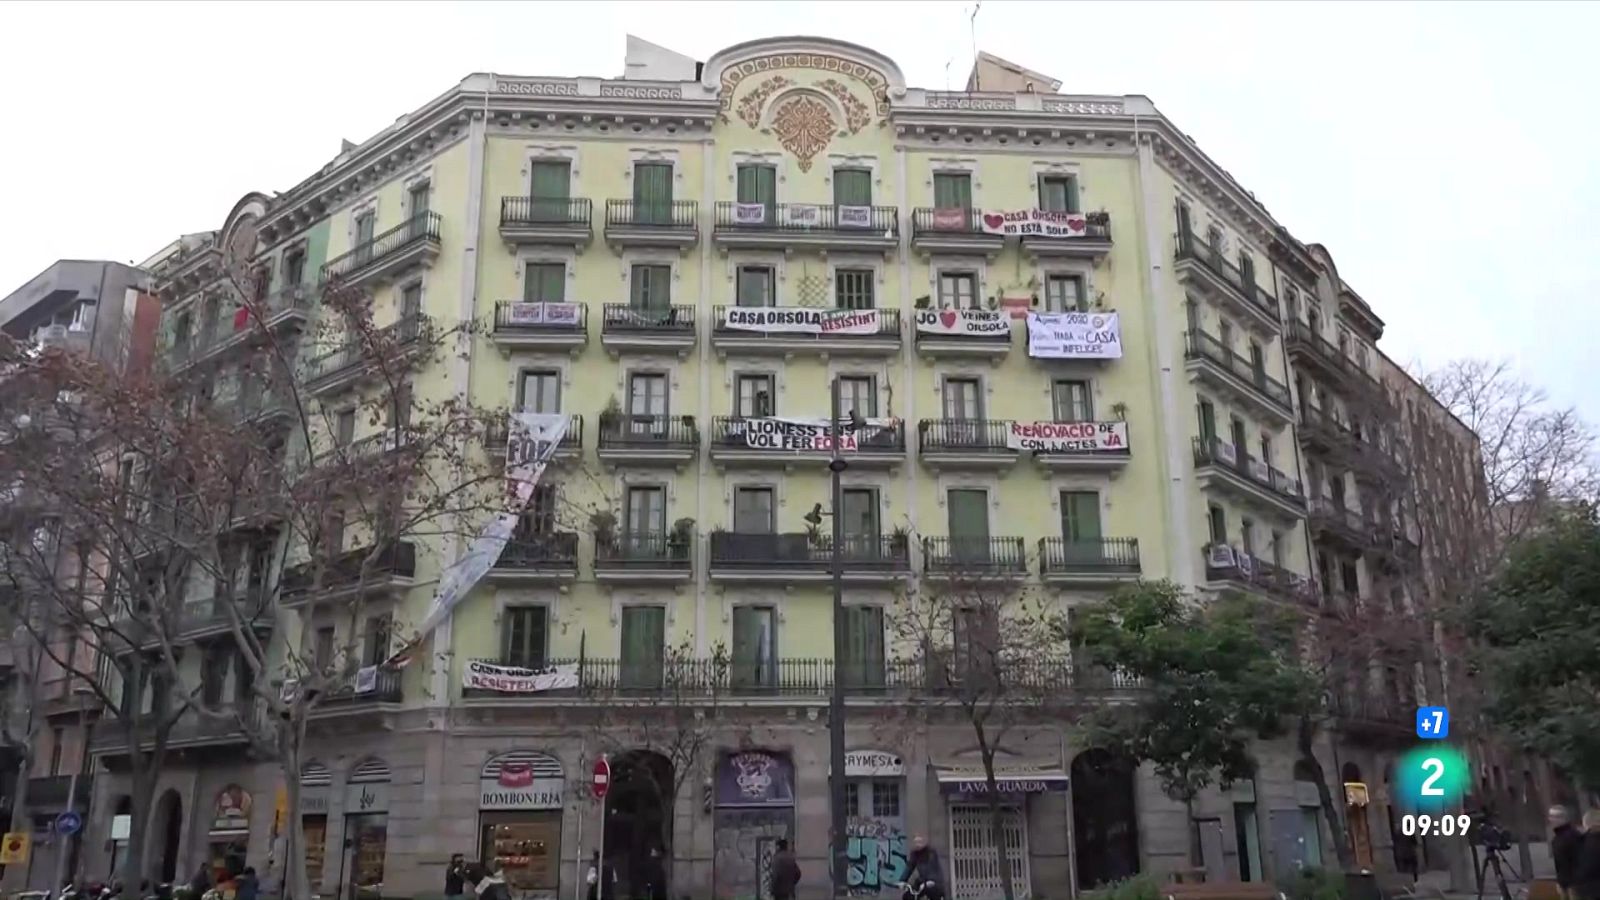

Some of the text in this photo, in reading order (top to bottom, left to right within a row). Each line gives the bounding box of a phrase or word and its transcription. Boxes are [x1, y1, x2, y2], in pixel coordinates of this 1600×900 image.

[1004, 211, 1028, 222] CASA
[1004, 225, 1017, 233] NO
[1046, 225, 1069, 235] SOLA
[729, 311, 766, 325] CASA
[767, 312, 821, 324] ORSOLA
[917, 310, 999, 324] JO VEINES
[966, 321, 1009, 332] ORSOLA
[1085, 330, 1117, 344] CASA
[747, 419, 818, 437] LIONESS
[1099, 423, 1115, 433] DE
[749, 432, 778, 447] VOL
[782, 435, 813, 449] FER
[1102, 434, 1122, 446] JA
[471, 675, 537, 689] RESISTEIX
